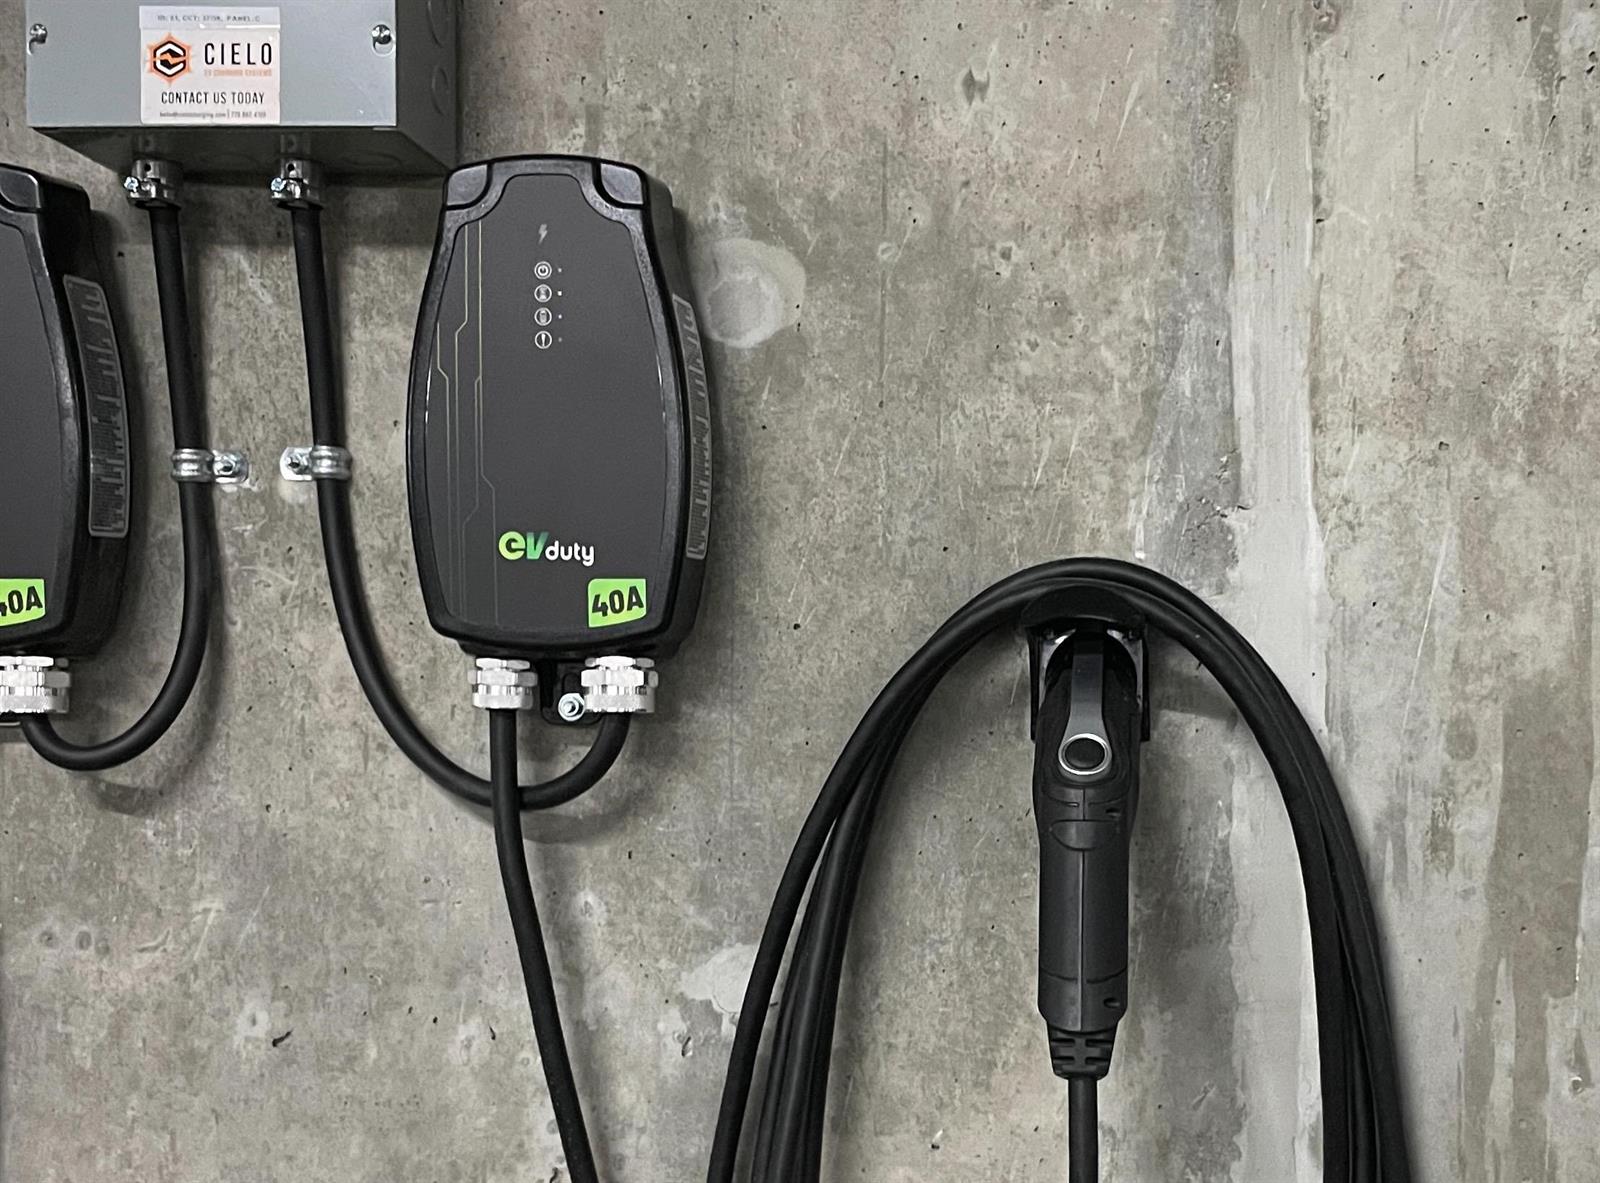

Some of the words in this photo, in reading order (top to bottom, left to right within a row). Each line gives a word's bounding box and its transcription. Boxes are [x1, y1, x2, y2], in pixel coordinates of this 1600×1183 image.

[204, 43, 272, 65] CIELO
[161, 91, 208, 104] CONTACT
[213, 91, 226, 104] US
[231, 91, 264, 104] TODAY
[592, 586, 644, 616] 40A
